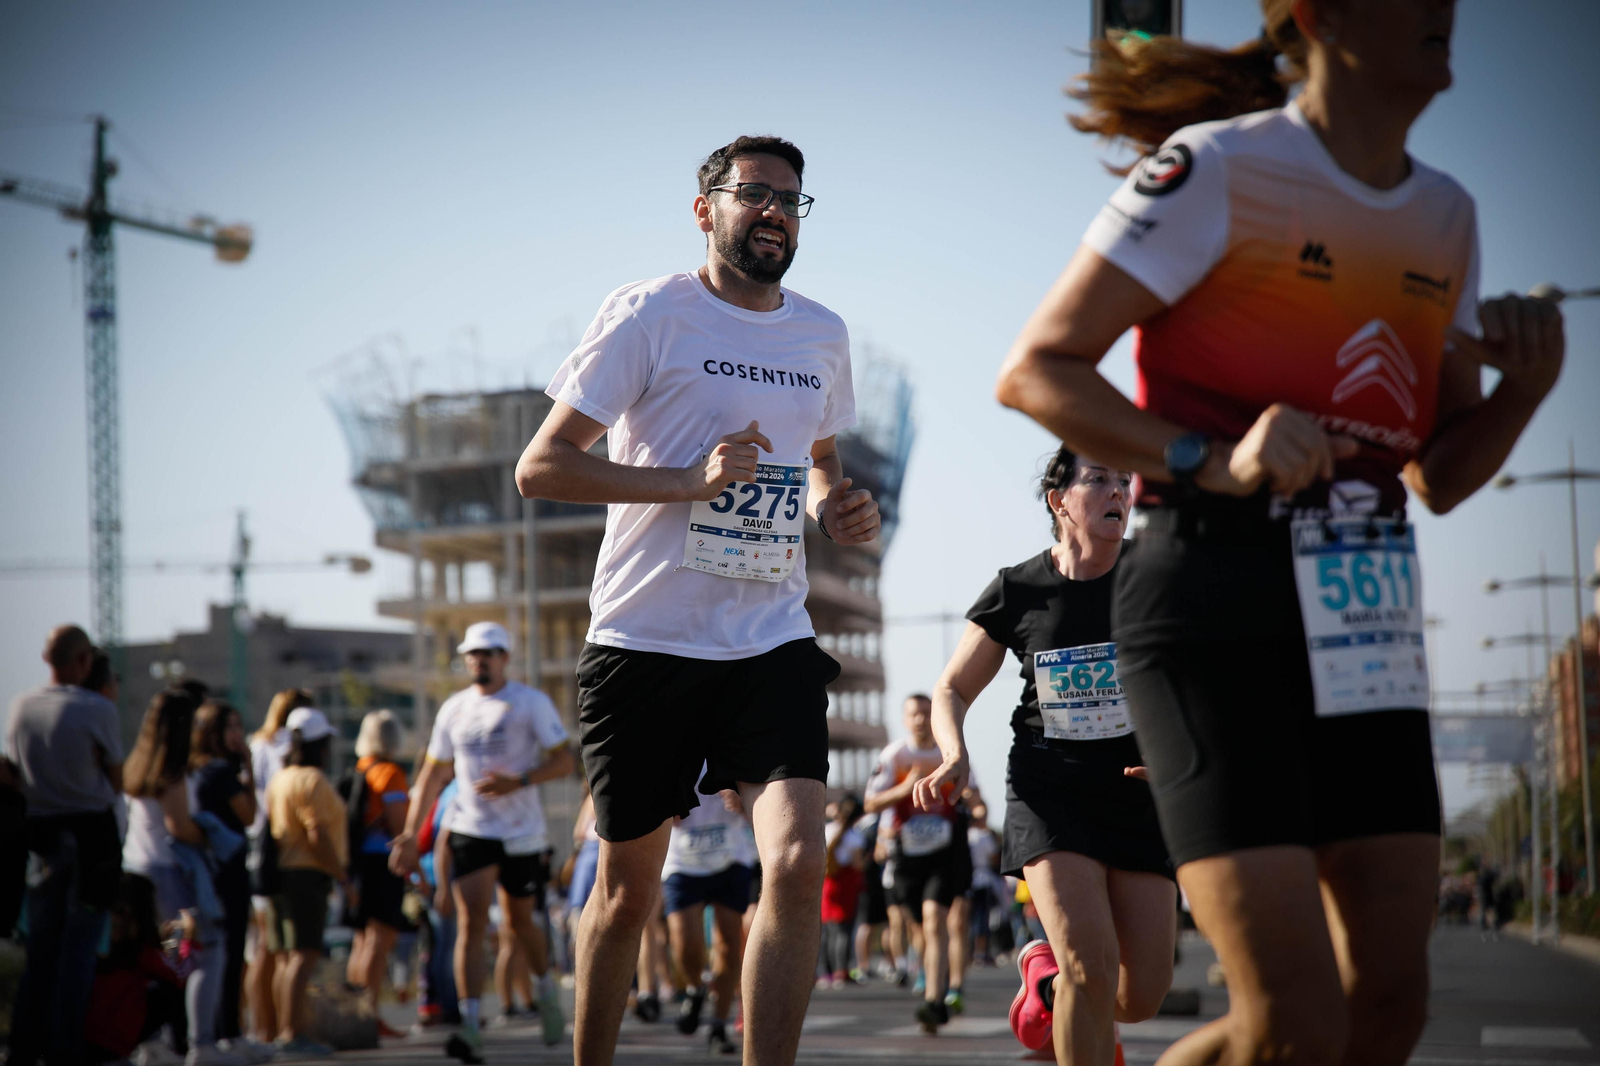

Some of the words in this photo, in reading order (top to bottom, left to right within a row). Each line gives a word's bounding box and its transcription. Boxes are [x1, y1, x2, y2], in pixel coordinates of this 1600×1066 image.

[703, 359, 821, 390] COSENTINO
[763, 466, 786, 474] Maratón
[769, 472, 785, 480] 2024
[709, 481, 800, 521] 5275
[742, 518, 773, 529] DAVID
[1317, 552, 1414, 612] 5611
[1071, 652, 1092, 661] Almería
[1057, 689, 1095, 699] SUSANA
[1097, 687, 1126, 697] FERLA
